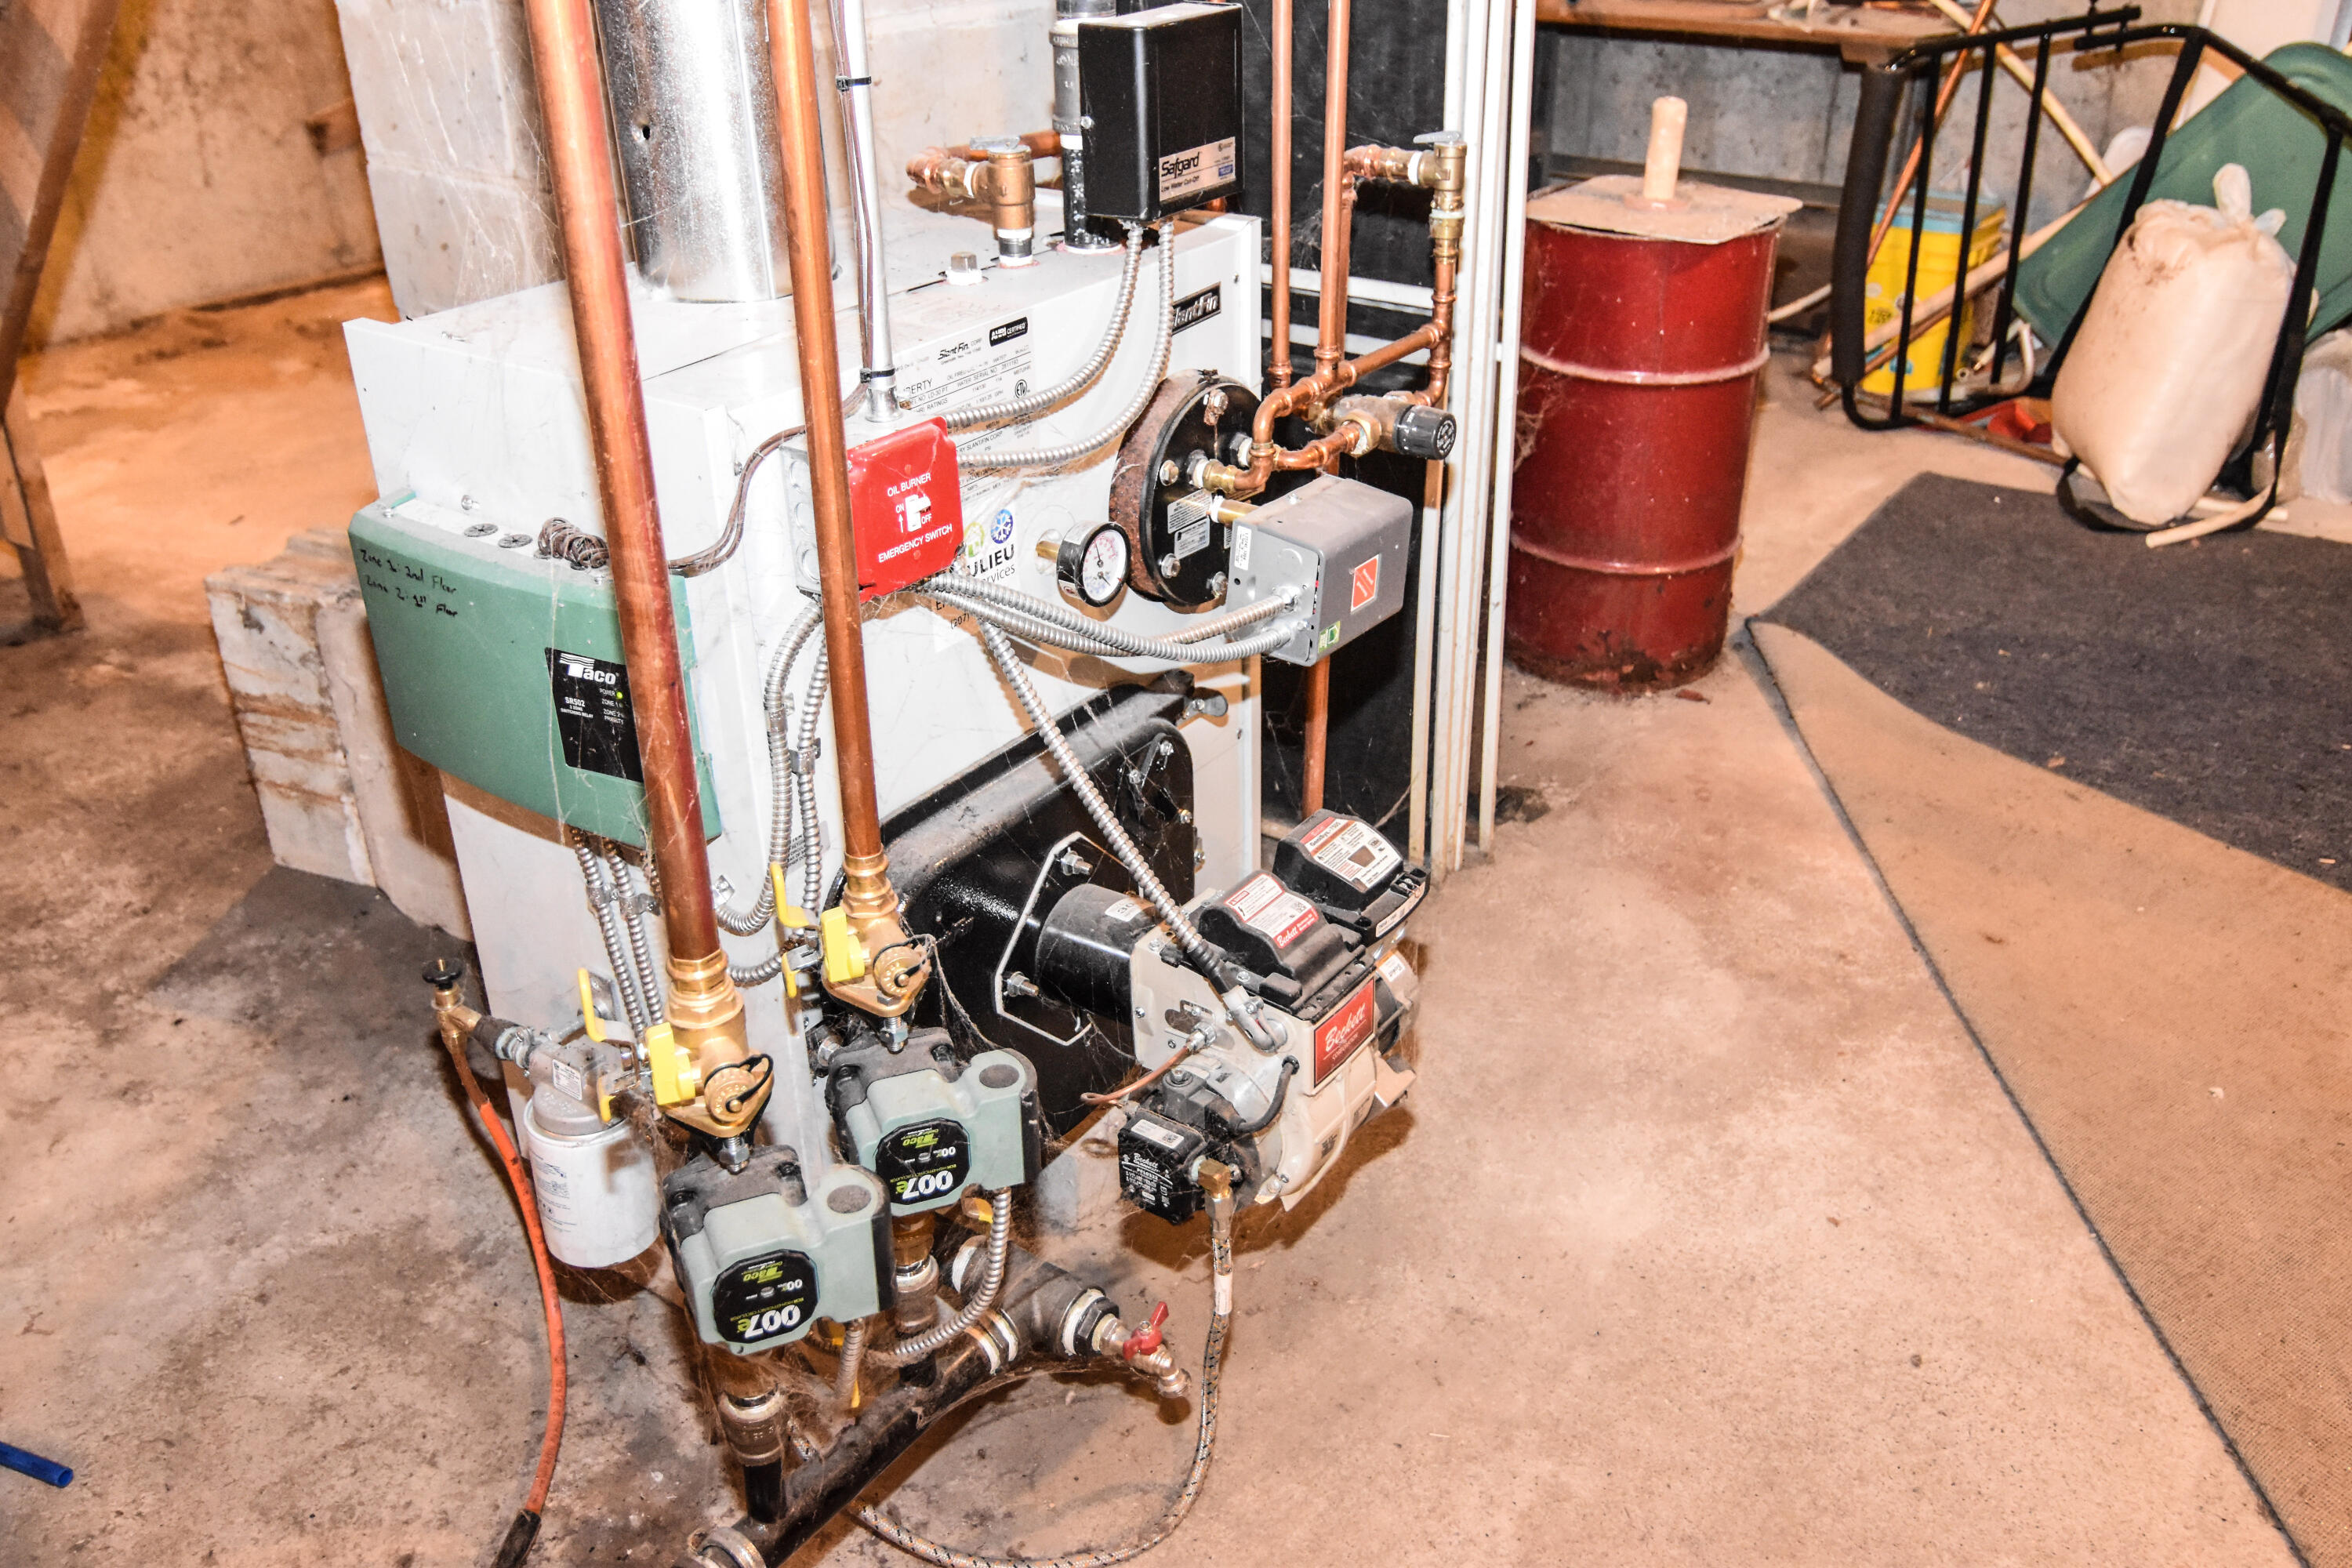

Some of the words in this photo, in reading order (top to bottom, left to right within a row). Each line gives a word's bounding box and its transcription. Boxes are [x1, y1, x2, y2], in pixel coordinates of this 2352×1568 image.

[1161, 151, 1201, 178] Safgard
[1173, 300, 1199, 327] lant
[973, 371, 989, 381] SERIAL
[927, 397, 948, 410] RATINGS
[887, 485, 901, 498] OIL
[901, 472, 932, 492] BURNER
[895, 503, 905, 514] ON
[920, 513, 932, 525] OFF
[877, 535, 924, 564] EMERGENCY
[924, 523, 953, 543] SWITCH
[967, 543, 1015, 578] ULIEU
[405, 565, 424, 582] 2nd
[432, 575, 457, 594] Floor
[436, 603, 458, 618] Floor
[559, 652, 617, 685] Taco
[599, 688, 616, 697] POWER
[564, 696, 586, 707] SR502
[601, 698, 615, 706] ZONE
[603, 708, 616, 717] ZONE
[1276, 926, 1298, 947] Beckett
[1325, 1003, 1366, 1052] Beckett
[902, 1133, 939, 1149] Taco
[1134, 1152, 1159, 1169] Beckett
[895, 1170, 953, 1200] 007e
[742, 1266, 783, 1283] Taco
[737, 1304, 800, 1339] 007e
